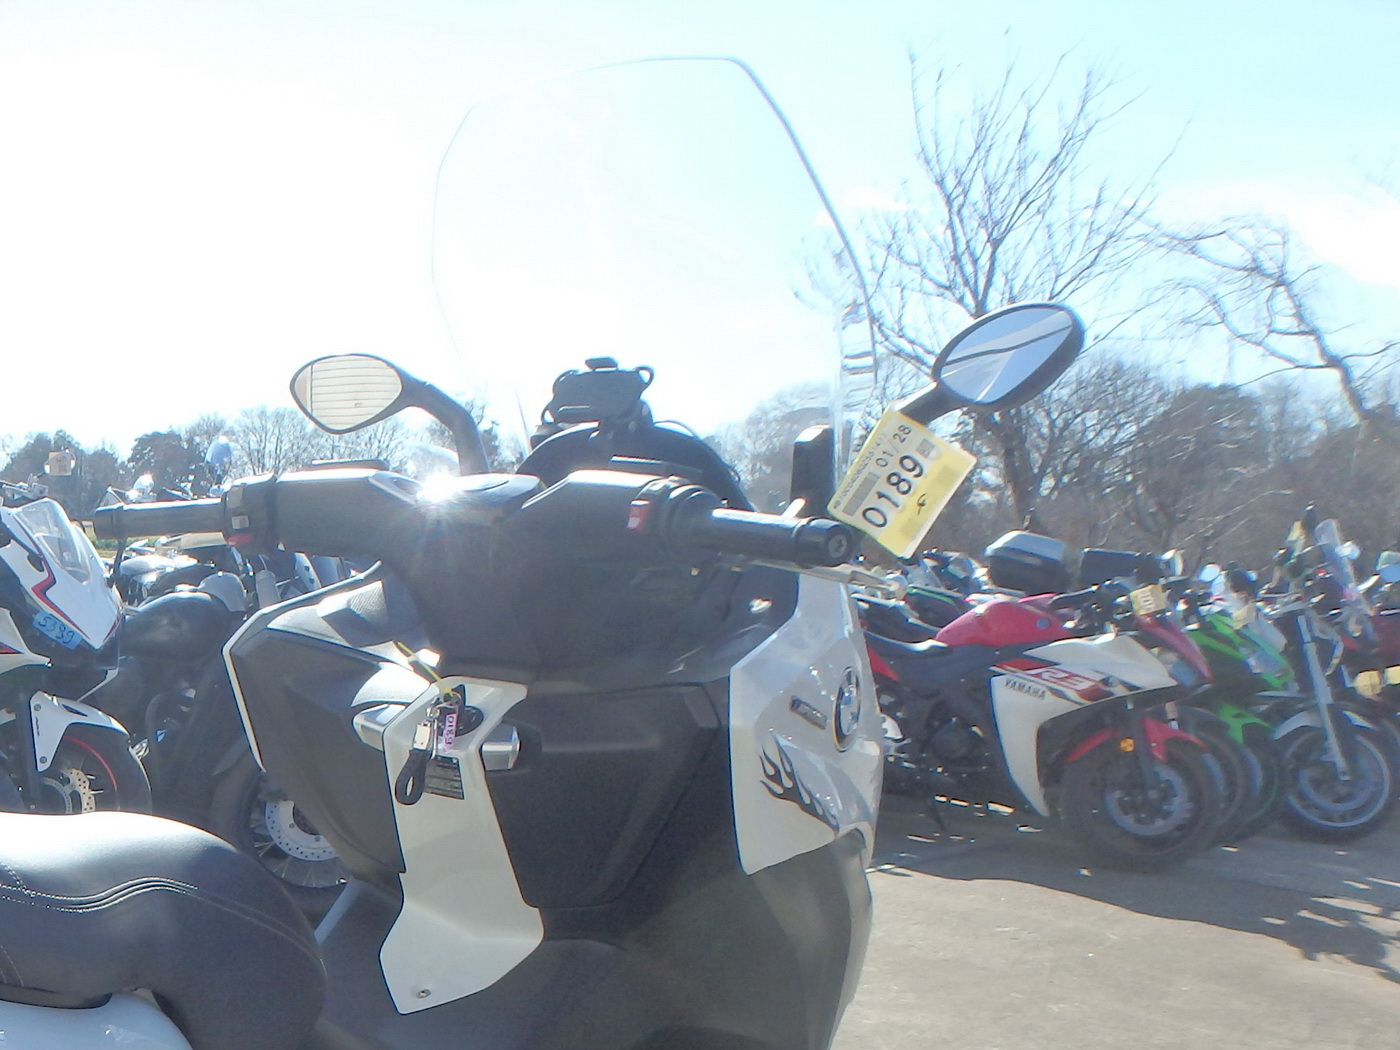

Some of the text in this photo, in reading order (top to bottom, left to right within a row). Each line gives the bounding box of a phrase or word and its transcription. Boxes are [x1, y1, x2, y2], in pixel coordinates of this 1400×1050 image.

[875, 424, 912, 468] 01/28
[861, 454, 924, 528] 0189
[1004, 678, 1047, 701] YAMAHA
